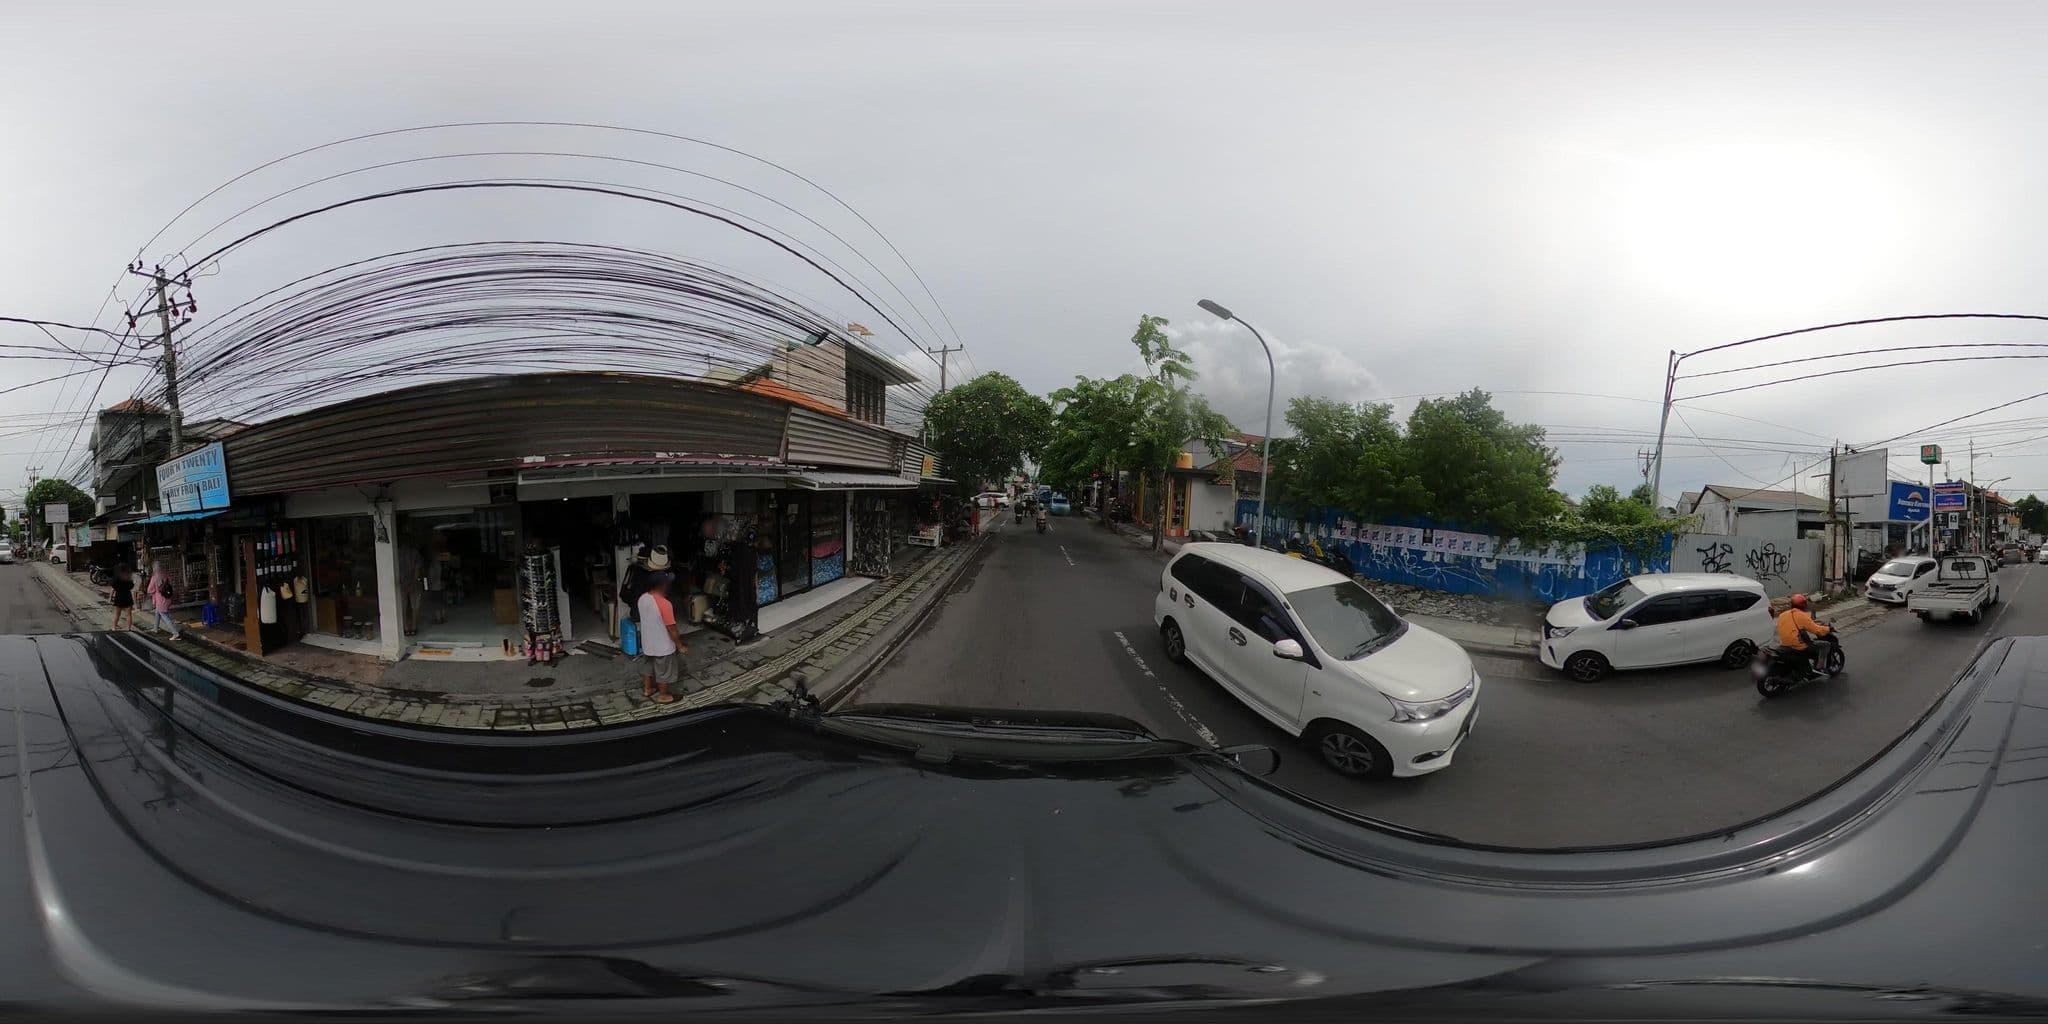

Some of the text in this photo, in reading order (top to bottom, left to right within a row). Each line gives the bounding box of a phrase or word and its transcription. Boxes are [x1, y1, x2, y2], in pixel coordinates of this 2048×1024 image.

[182, 448, 217, 469] TWENTY
[181, 482, 200, 495] FROM
[202, 477, 221, 491] BALI
